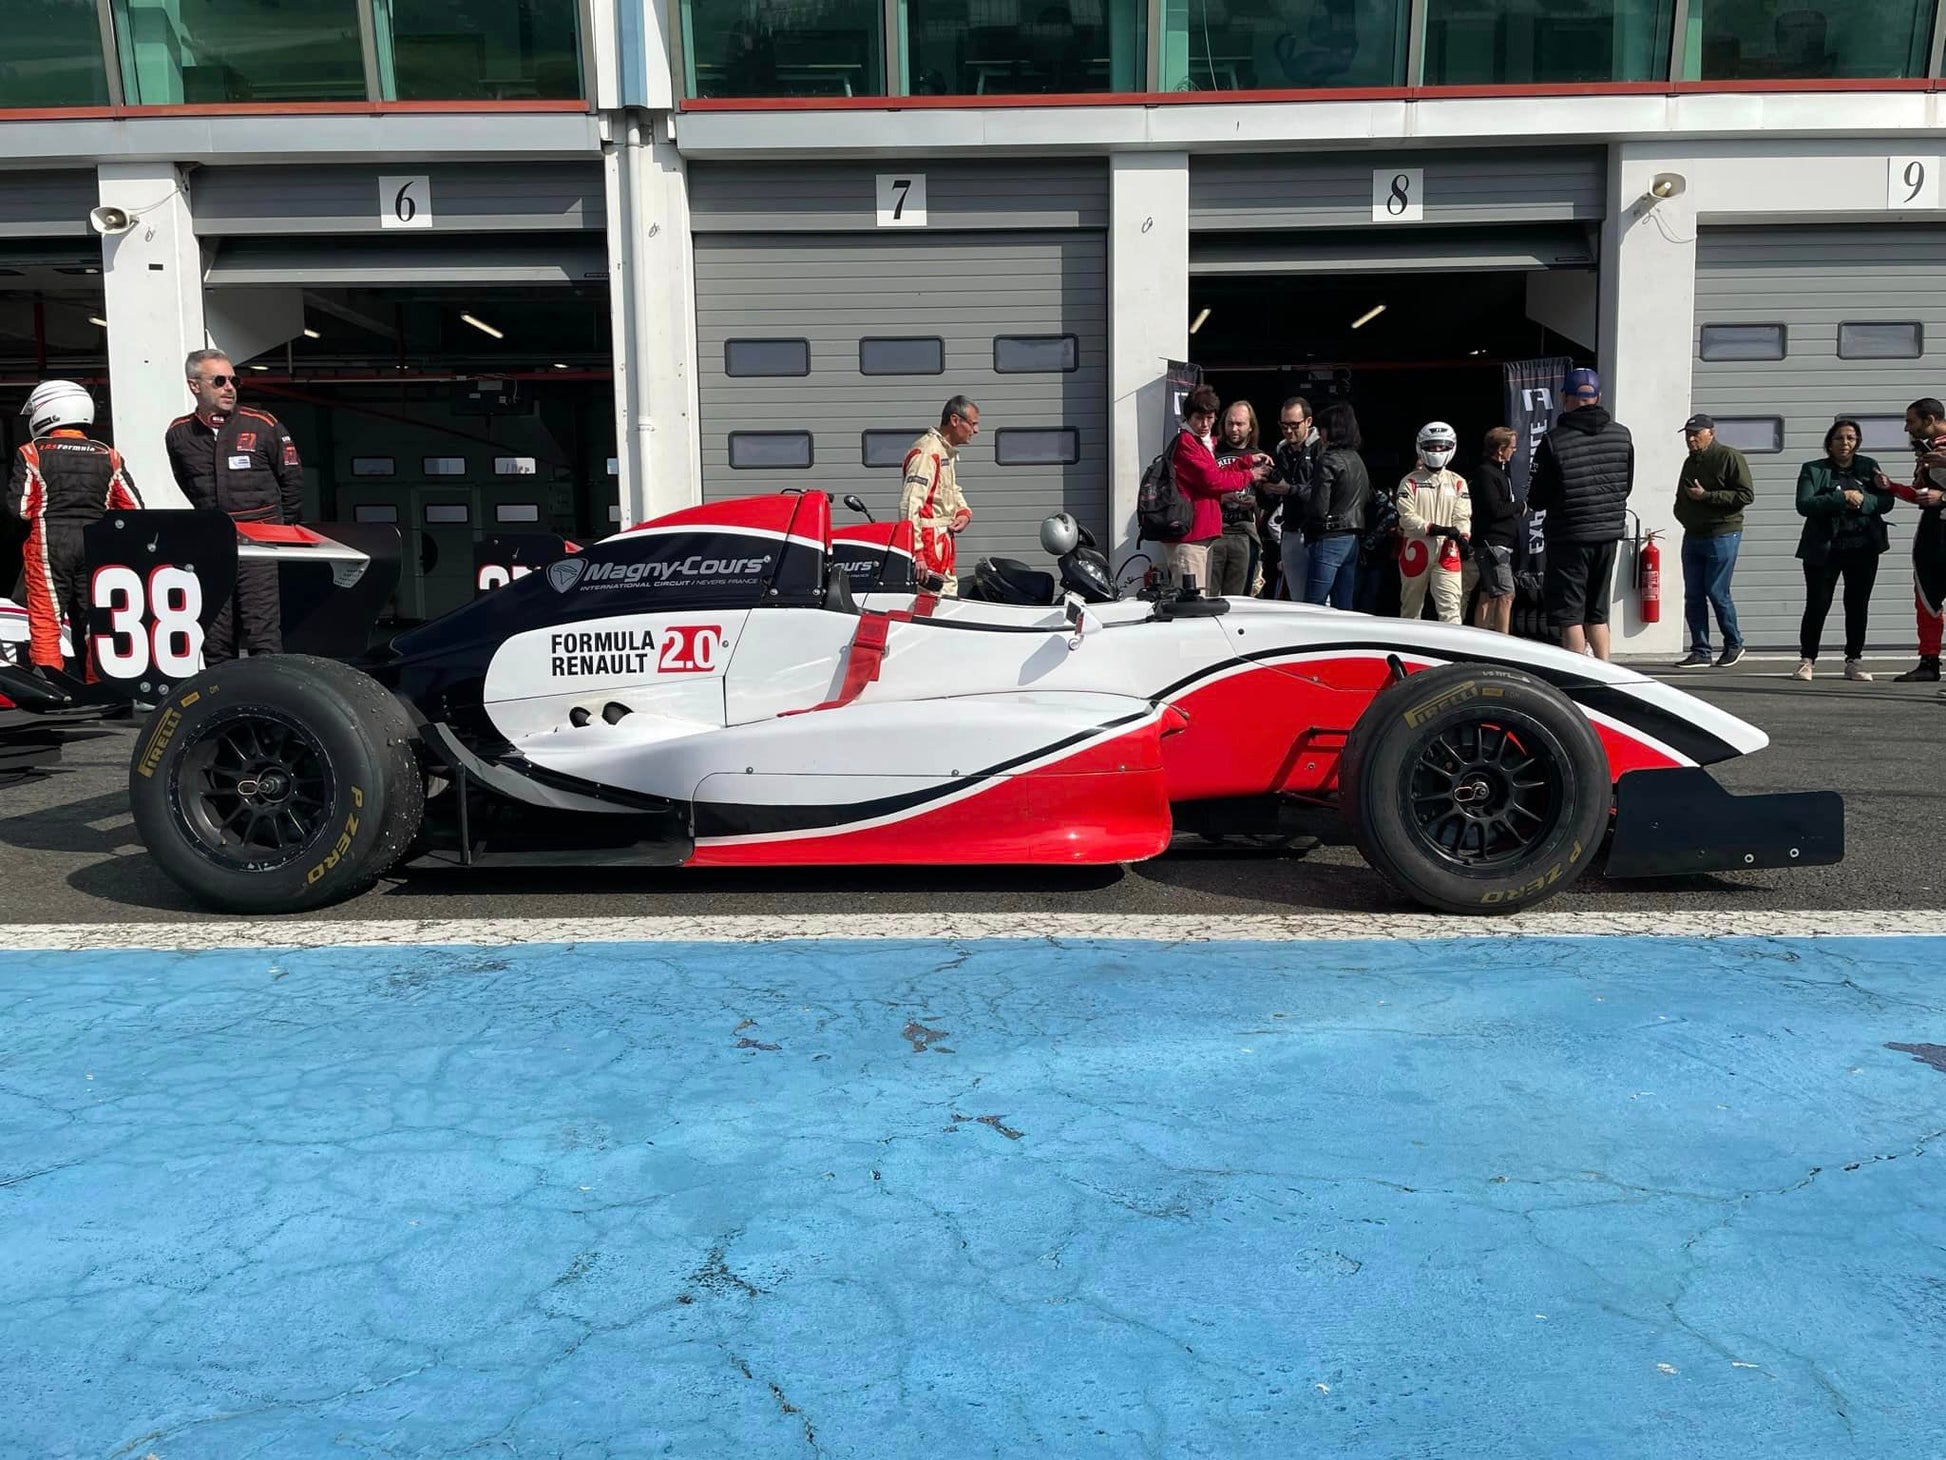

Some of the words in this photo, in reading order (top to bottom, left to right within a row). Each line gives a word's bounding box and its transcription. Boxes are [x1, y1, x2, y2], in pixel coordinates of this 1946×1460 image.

[395, 181, 415, 222] 6
[892, 180, 911, 220] 7
[1387, 174, 1409, 215] 8
[1903, 161, 1924, 203] 9
[580, 581, 651, 592] INTERNATIONAL
[583, 556, 765, 583] Magny-Cours
[92, 564, 205, 678] 38
[551, 630, 655, 655] FORMULA
[658, 628, 722, 672] 2.0
[551, 653, 648, 677] RENAULT
[138, 706, 182, 777] PIRELLI
[351, 786, 363, 808] P
[307, 812, 360, 885] ZERO
[1569, 840, 1582, 864] P
